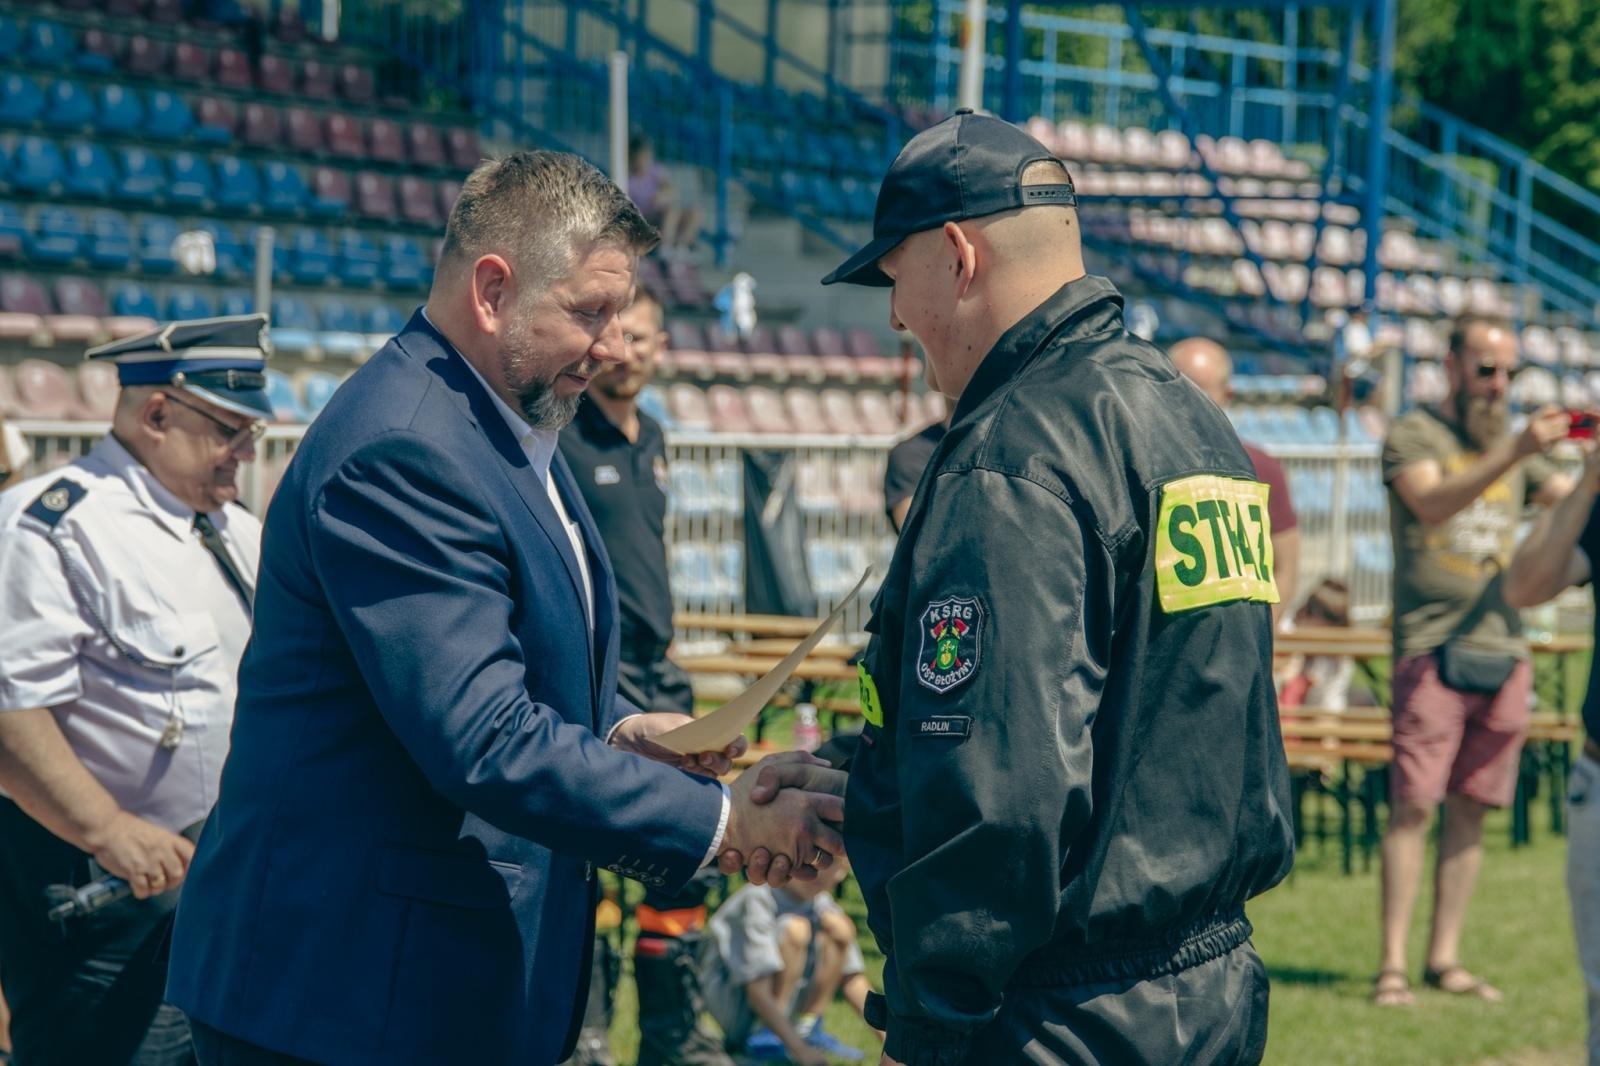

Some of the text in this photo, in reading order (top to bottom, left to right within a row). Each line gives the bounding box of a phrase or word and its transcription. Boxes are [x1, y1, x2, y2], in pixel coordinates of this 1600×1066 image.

[930, 604, 973, 624] KSRG
[920, 662, 936, 682] OSP
[920, 720, 950, 732] RADLIN
